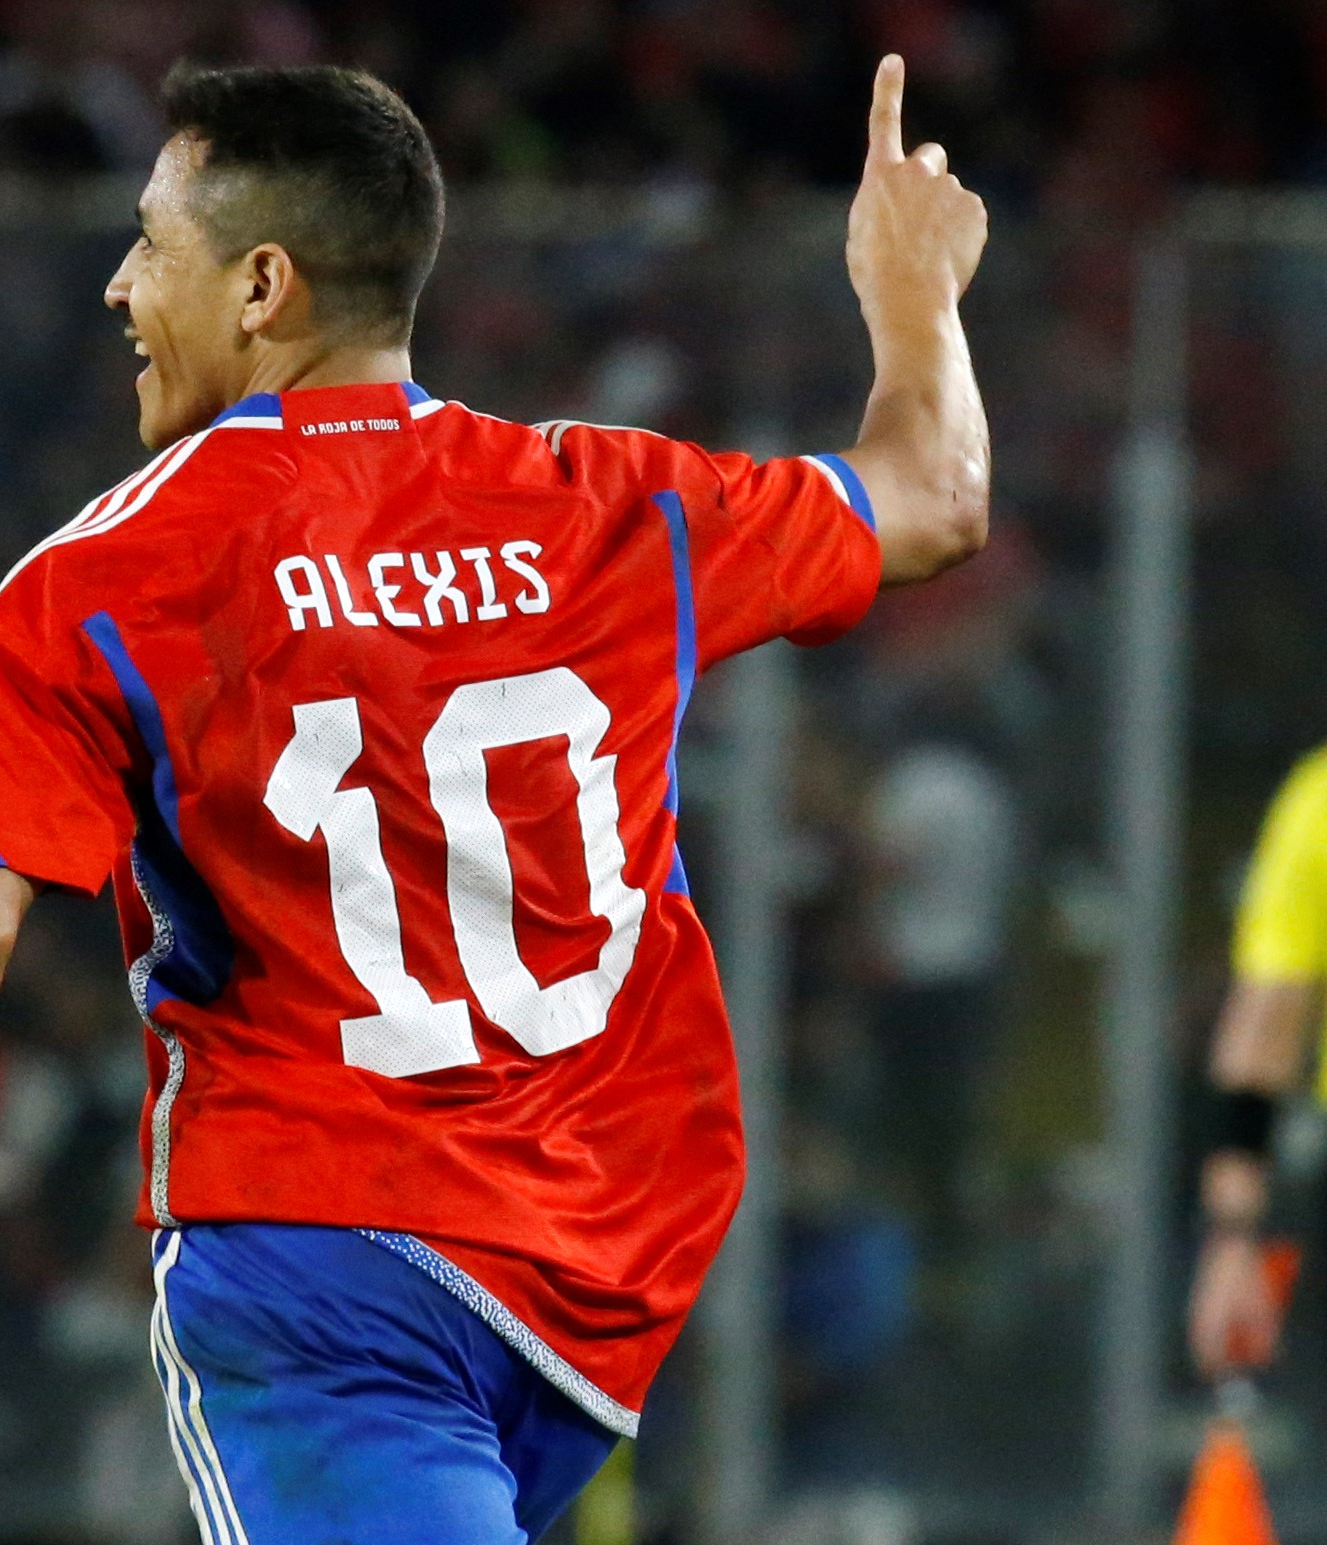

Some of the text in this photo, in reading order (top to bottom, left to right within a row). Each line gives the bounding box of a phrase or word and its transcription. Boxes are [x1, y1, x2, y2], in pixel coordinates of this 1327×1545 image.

[301, 419, 400, 436] LA ROJA DE TODOS
[274, 540, 551, 630] ALEXIS
[263, 667, 647, 1078] 10
